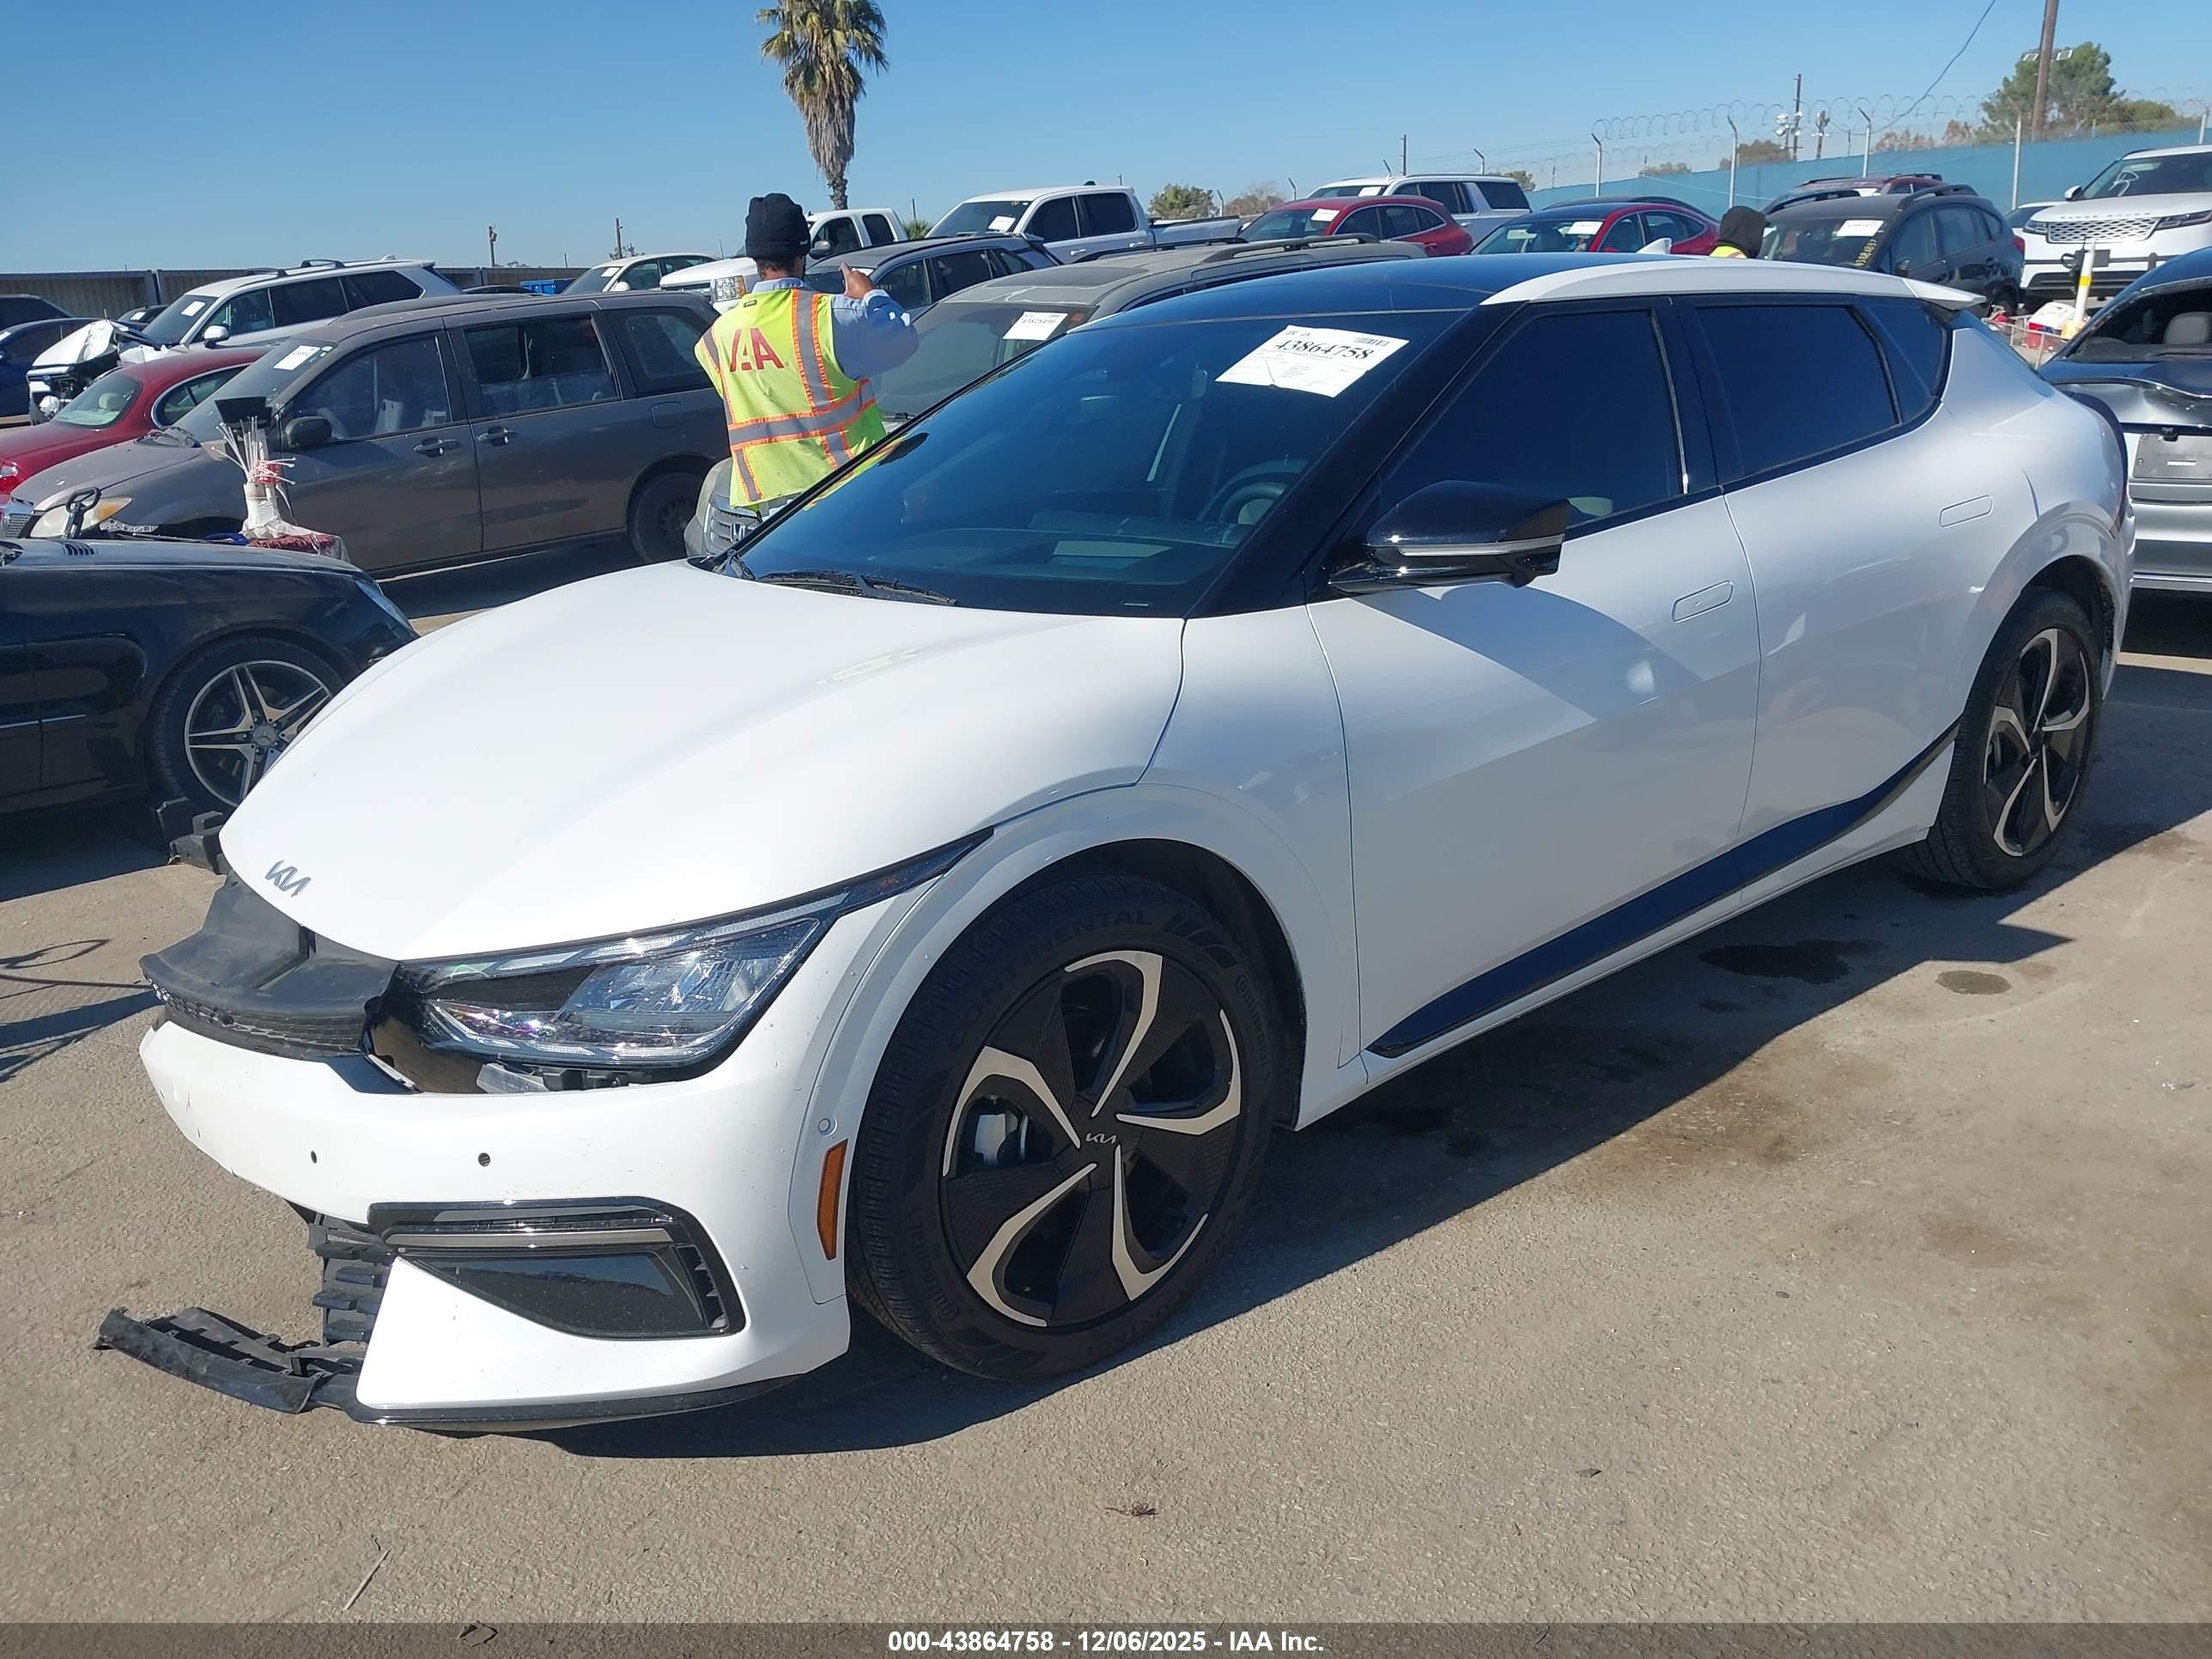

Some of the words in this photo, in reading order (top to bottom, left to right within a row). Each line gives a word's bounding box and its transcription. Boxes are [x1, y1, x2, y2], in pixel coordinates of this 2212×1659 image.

[1275, 339, 1374, 360] 43864758
[264, 860, 312, 897] KIA
[1085, 1133, 1116, 1144] KIA
